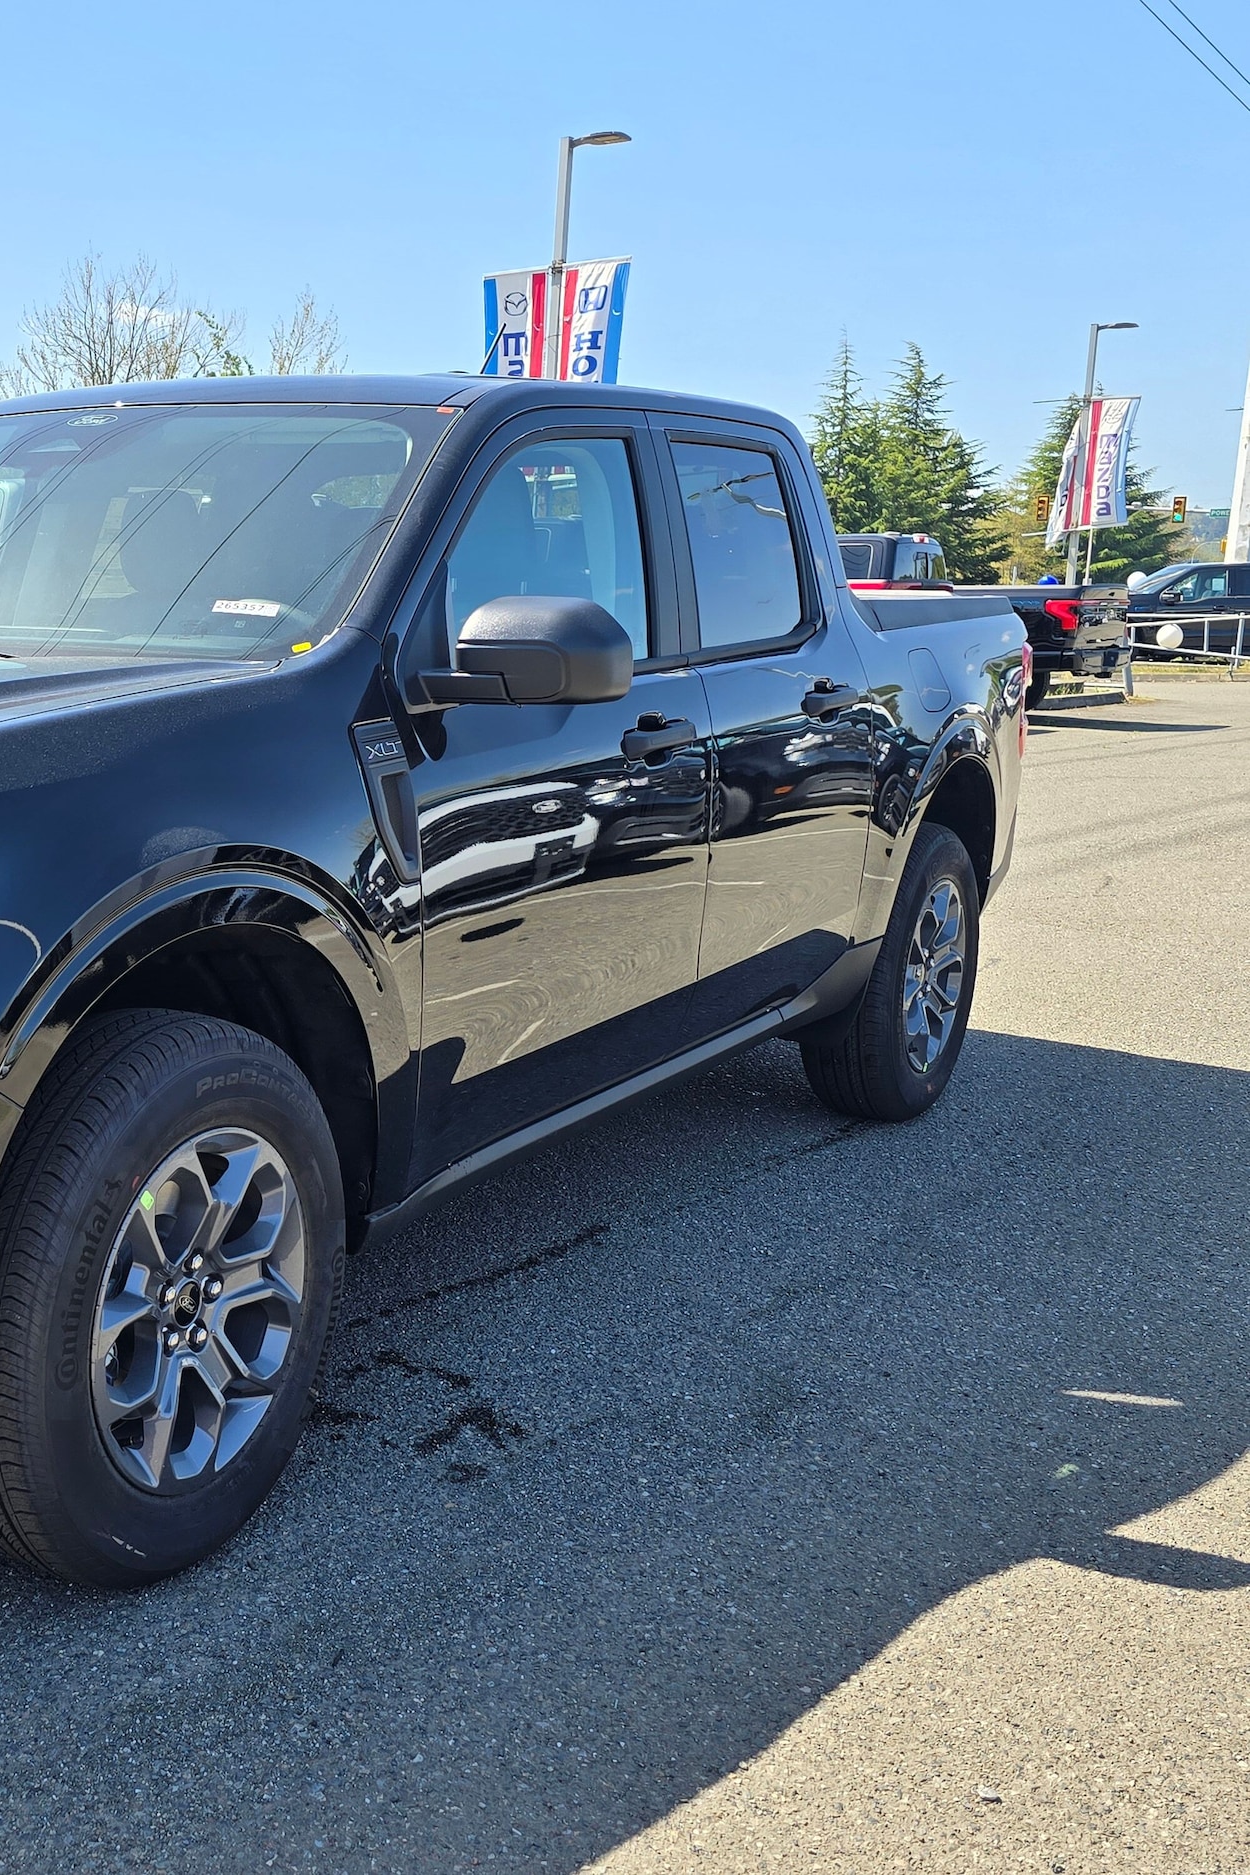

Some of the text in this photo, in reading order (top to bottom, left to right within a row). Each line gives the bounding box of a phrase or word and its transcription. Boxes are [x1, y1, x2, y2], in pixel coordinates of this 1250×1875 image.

[572, 330, 604, 382] HO
[216, 602, 265, 611] 265357
[365, 740, 402, 760] XLT
[53, 1200, 112, 1391] Continental
